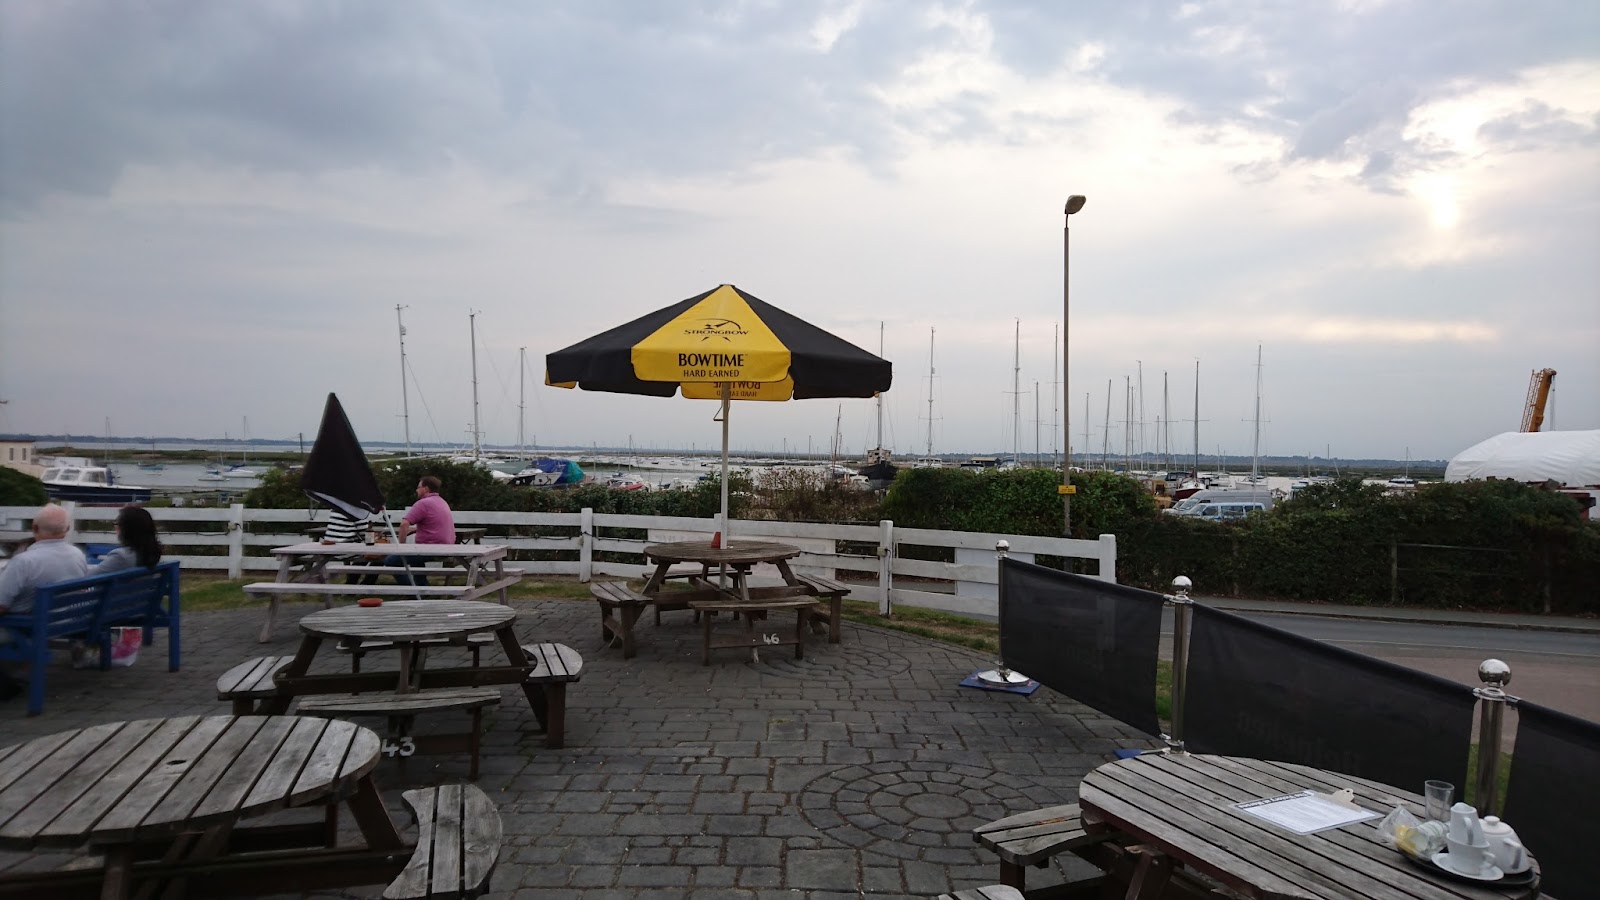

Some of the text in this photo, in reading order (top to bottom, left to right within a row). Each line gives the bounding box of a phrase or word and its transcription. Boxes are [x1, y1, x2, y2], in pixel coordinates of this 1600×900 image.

[678, 353, 744, 367] BOWTIME
[762, 633, 780, 645] 46
[381, 736, 416, 757] 43
